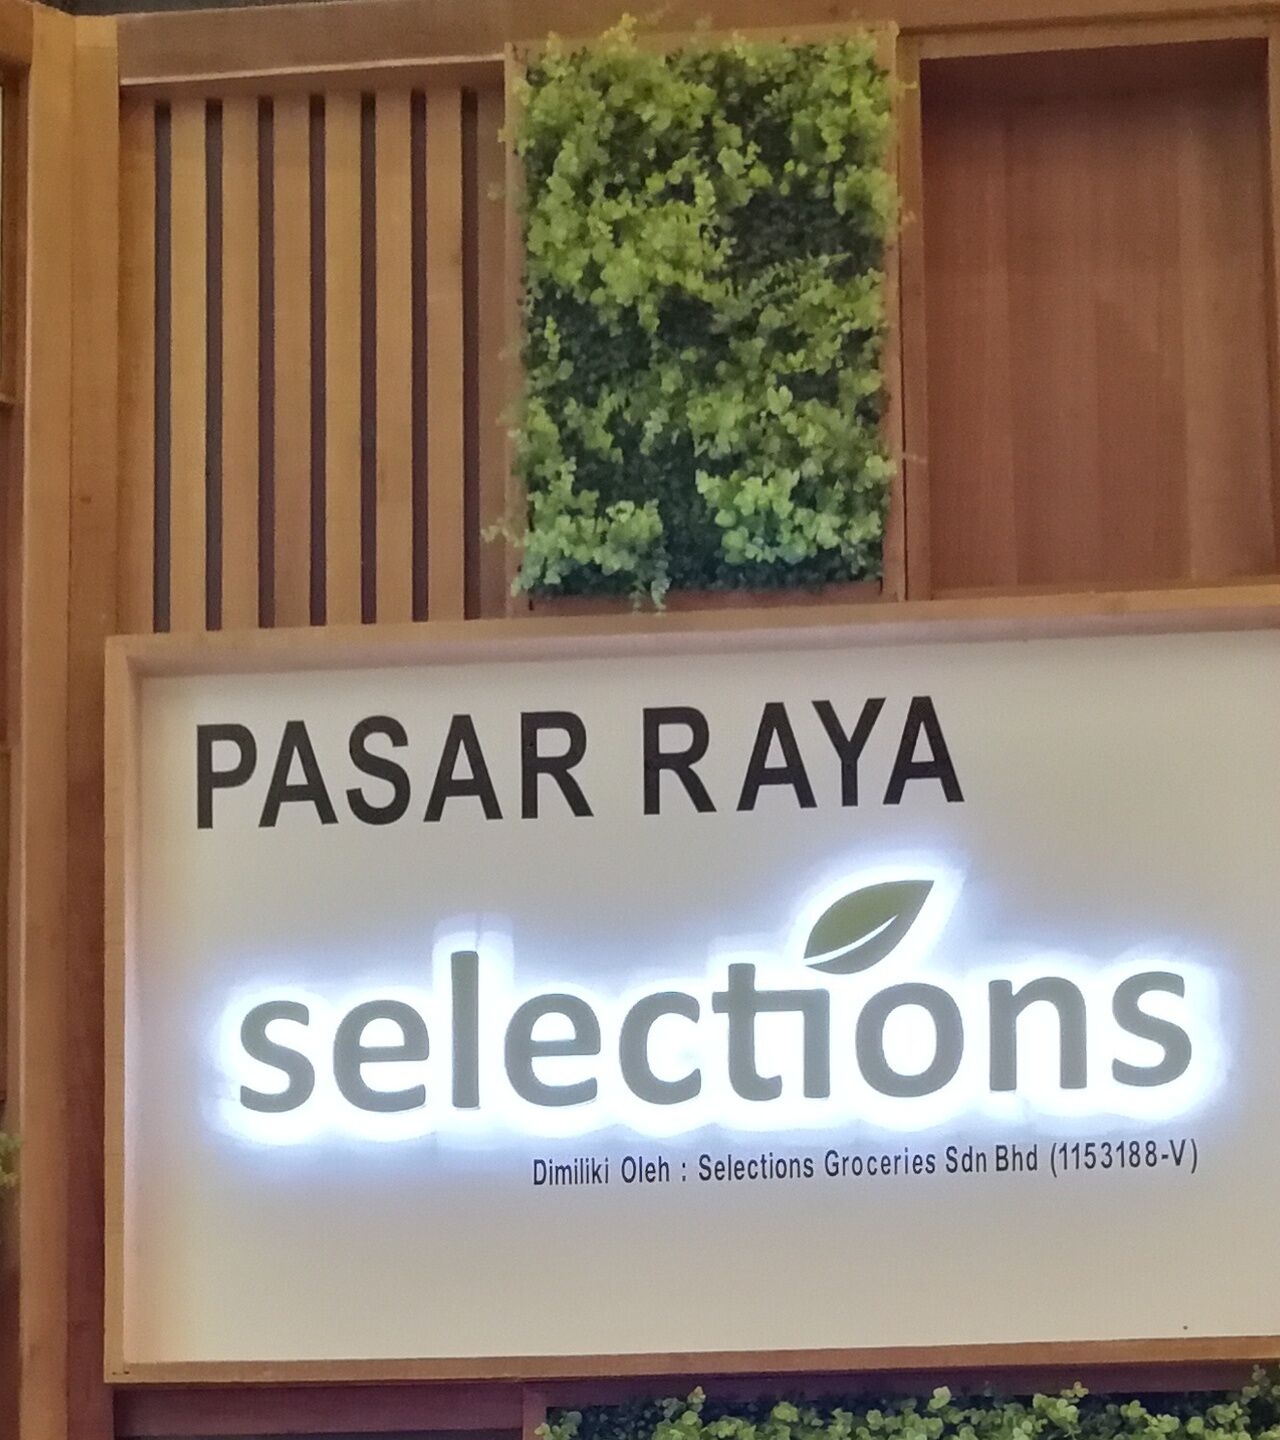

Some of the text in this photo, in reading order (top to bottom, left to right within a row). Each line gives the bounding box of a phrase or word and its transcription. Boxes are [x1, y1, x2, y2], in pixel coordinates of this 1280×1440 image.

[195, 694, 965, 830] PASAR RAYA
[238, 948, 1194, 1113] selections
[533, 1157, 610, 1186] Dimiliki
[620, 1155, 671, 1184] Oleh
[698, 1152, 815, 1182] Selections
[824, 1147, 937, 1177] Groceries
[945, 1144, 988, 1174] Sdn
[995, 1143, 1039, 1173] Bhd
[1050, 1138, 1199, 1179] (1153188-V)
